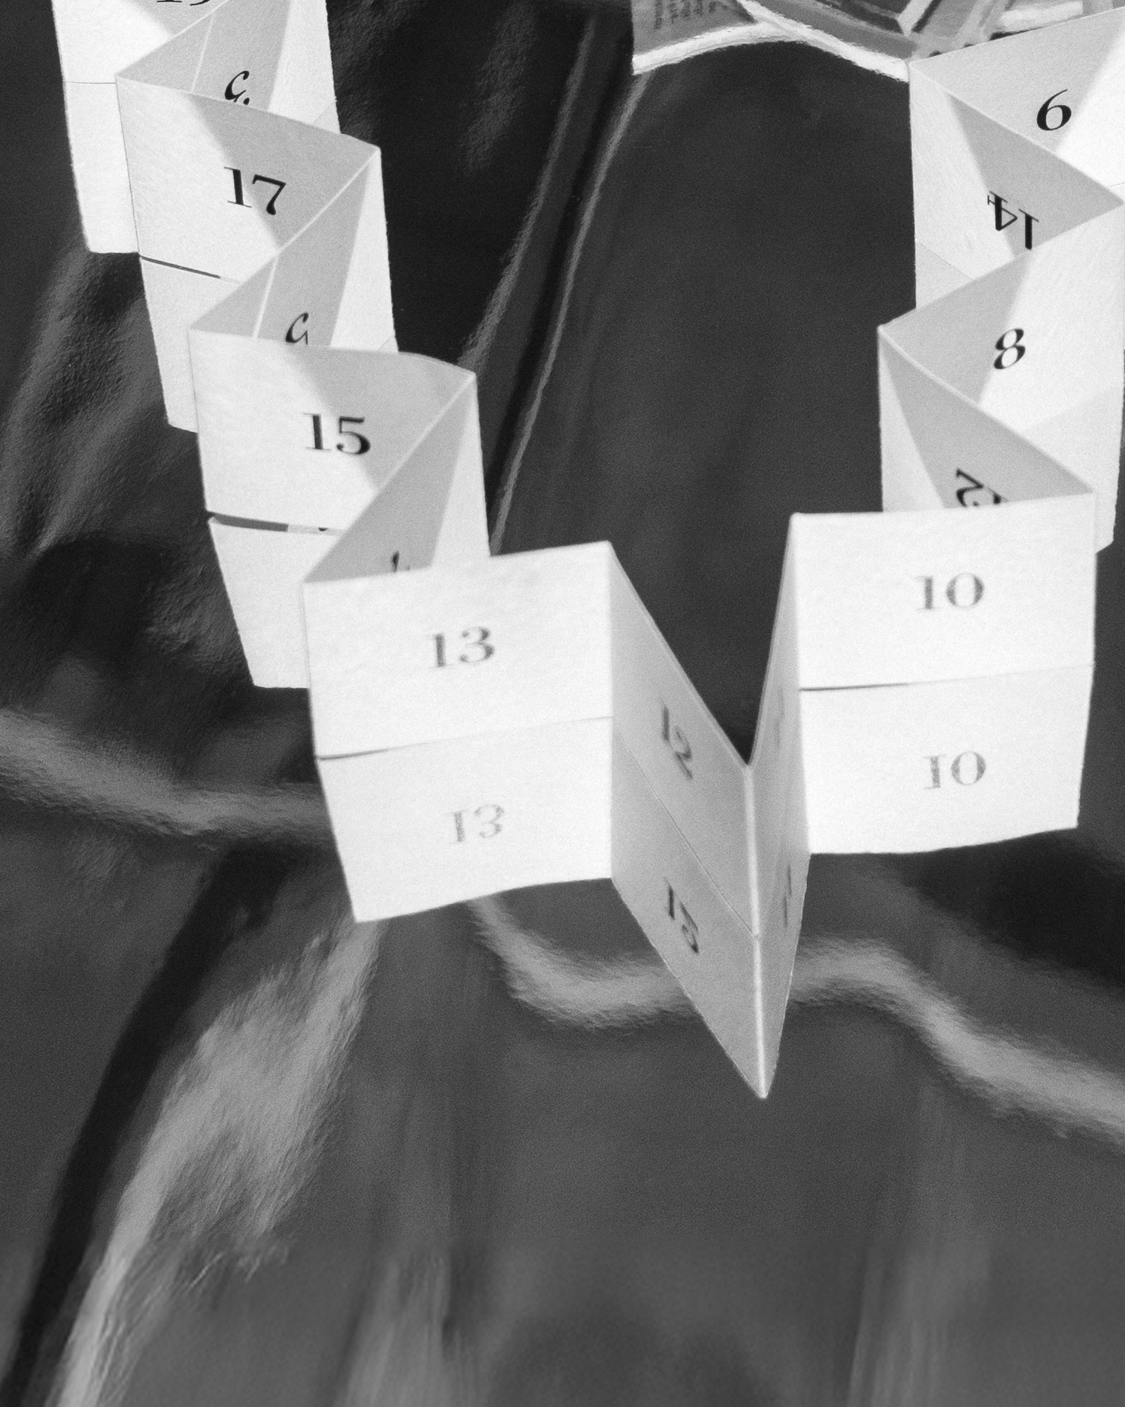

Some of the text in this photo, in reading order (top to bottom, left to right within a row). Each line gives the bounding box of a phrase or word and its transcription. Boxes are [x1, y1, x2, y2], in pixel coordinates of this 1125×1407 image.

[1036, 89, 1072, 132] 6
[222, 165, 287, 216] 17
[993, 327, 1026, 370] 8
[302, 411, 371, 456] 15
[914, 571, 984, 612] 10
[425, 625, 496, 669] 13
